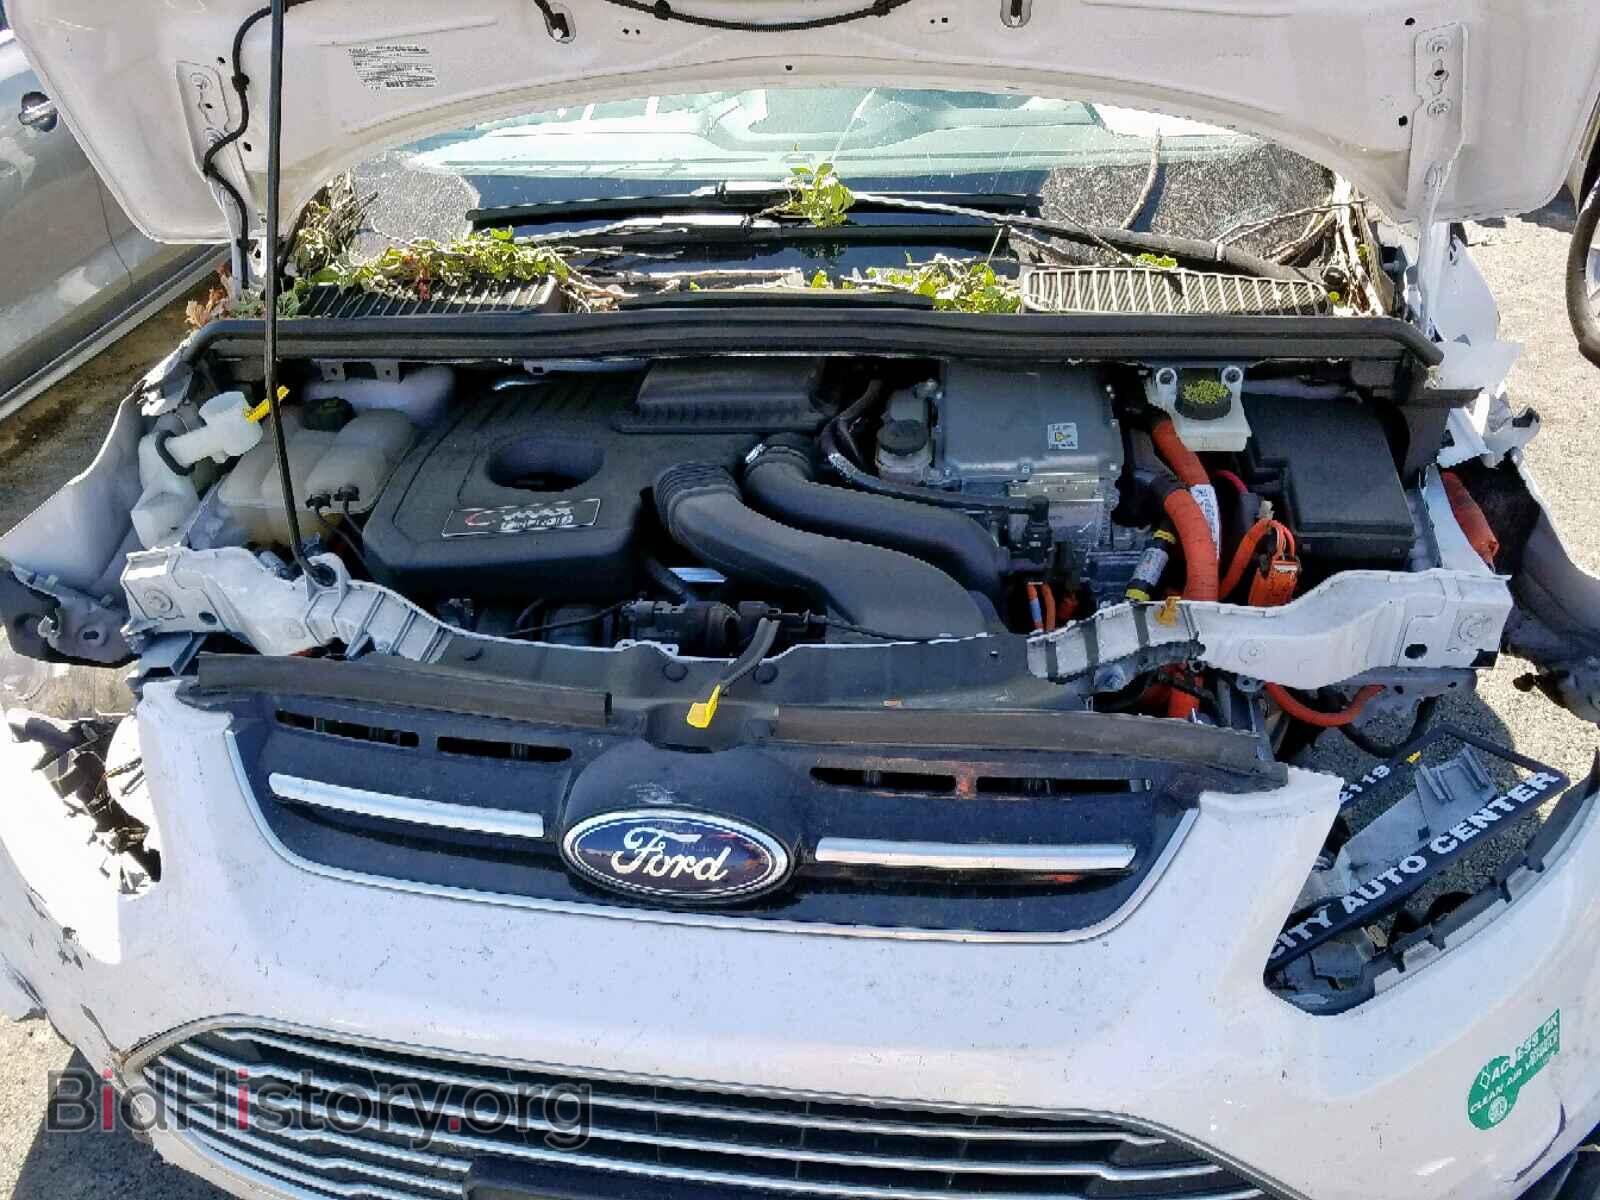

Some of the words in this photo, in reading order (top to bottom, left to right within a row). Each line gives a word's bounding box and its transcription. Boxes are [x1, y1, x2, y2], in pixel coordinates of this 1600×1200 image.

[610, 826, 732, 881] Ford
[1341, 855, 1427, 914] AUTO
[1430, 771, 1560, 854] CENTER
